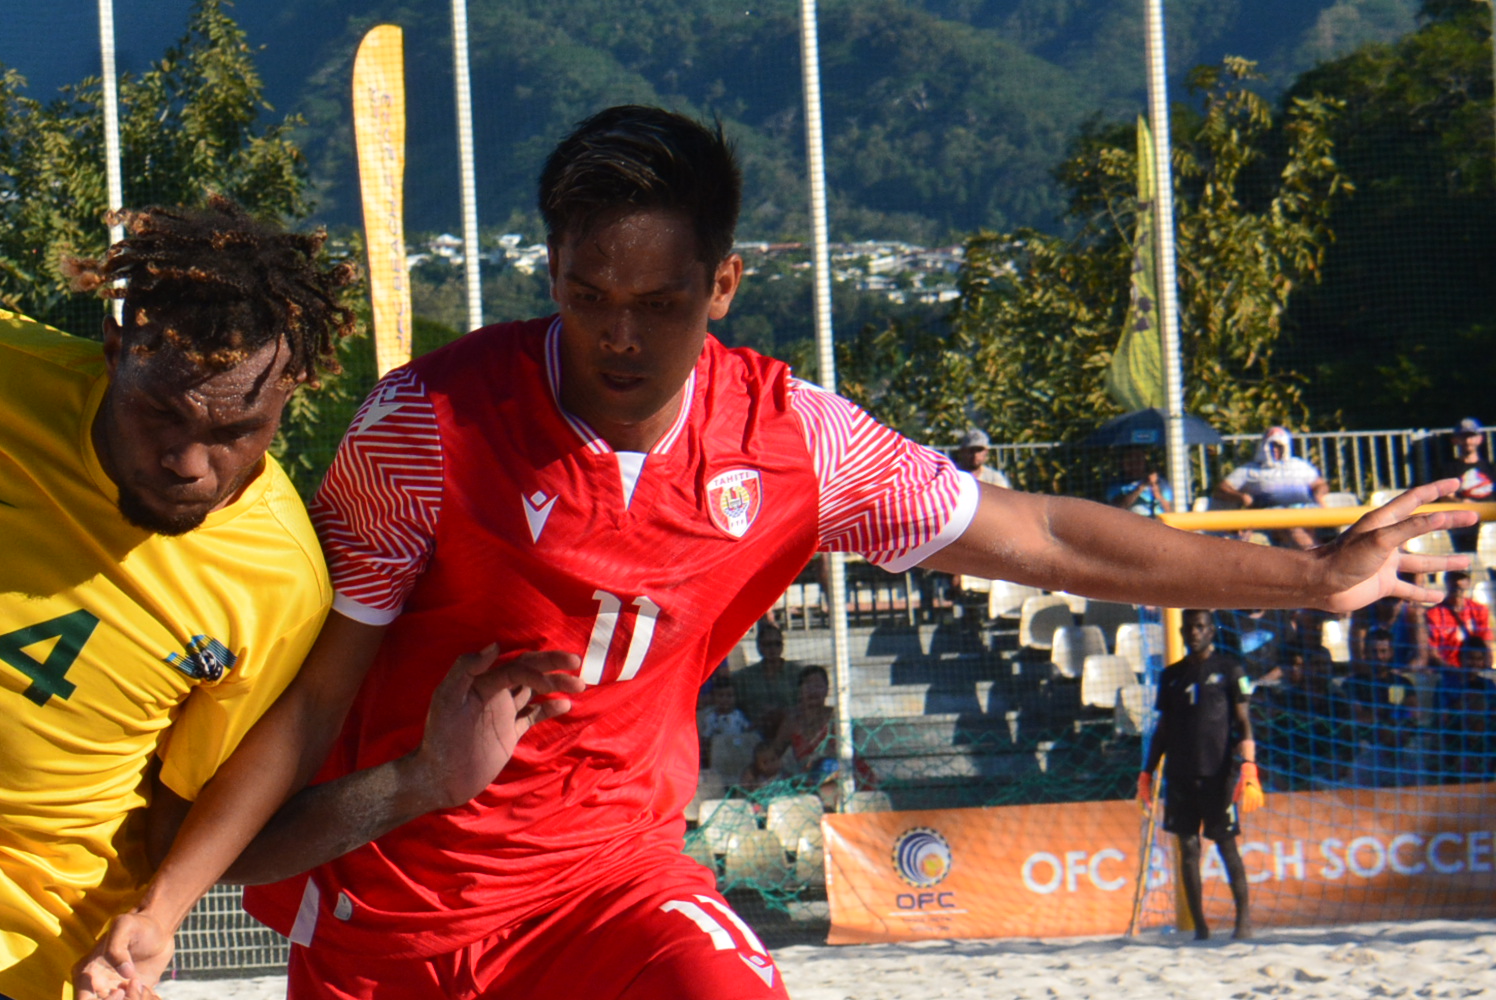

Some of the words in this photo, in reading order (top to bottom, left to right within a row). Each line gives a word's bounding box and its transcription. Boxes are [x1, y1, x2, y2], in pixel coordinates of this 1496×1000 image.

[713, 471, 750, 487] TAHITI
[579, 589, 661, 686] 11
[1021, 848, 1128, 894] OFC
[1145, 840, 1305, 889] BACH
[1320, 831, 1496, 879] SOCCE
[659, 894, 768, 957] 11
[896, 892, 956, 910] OFC
